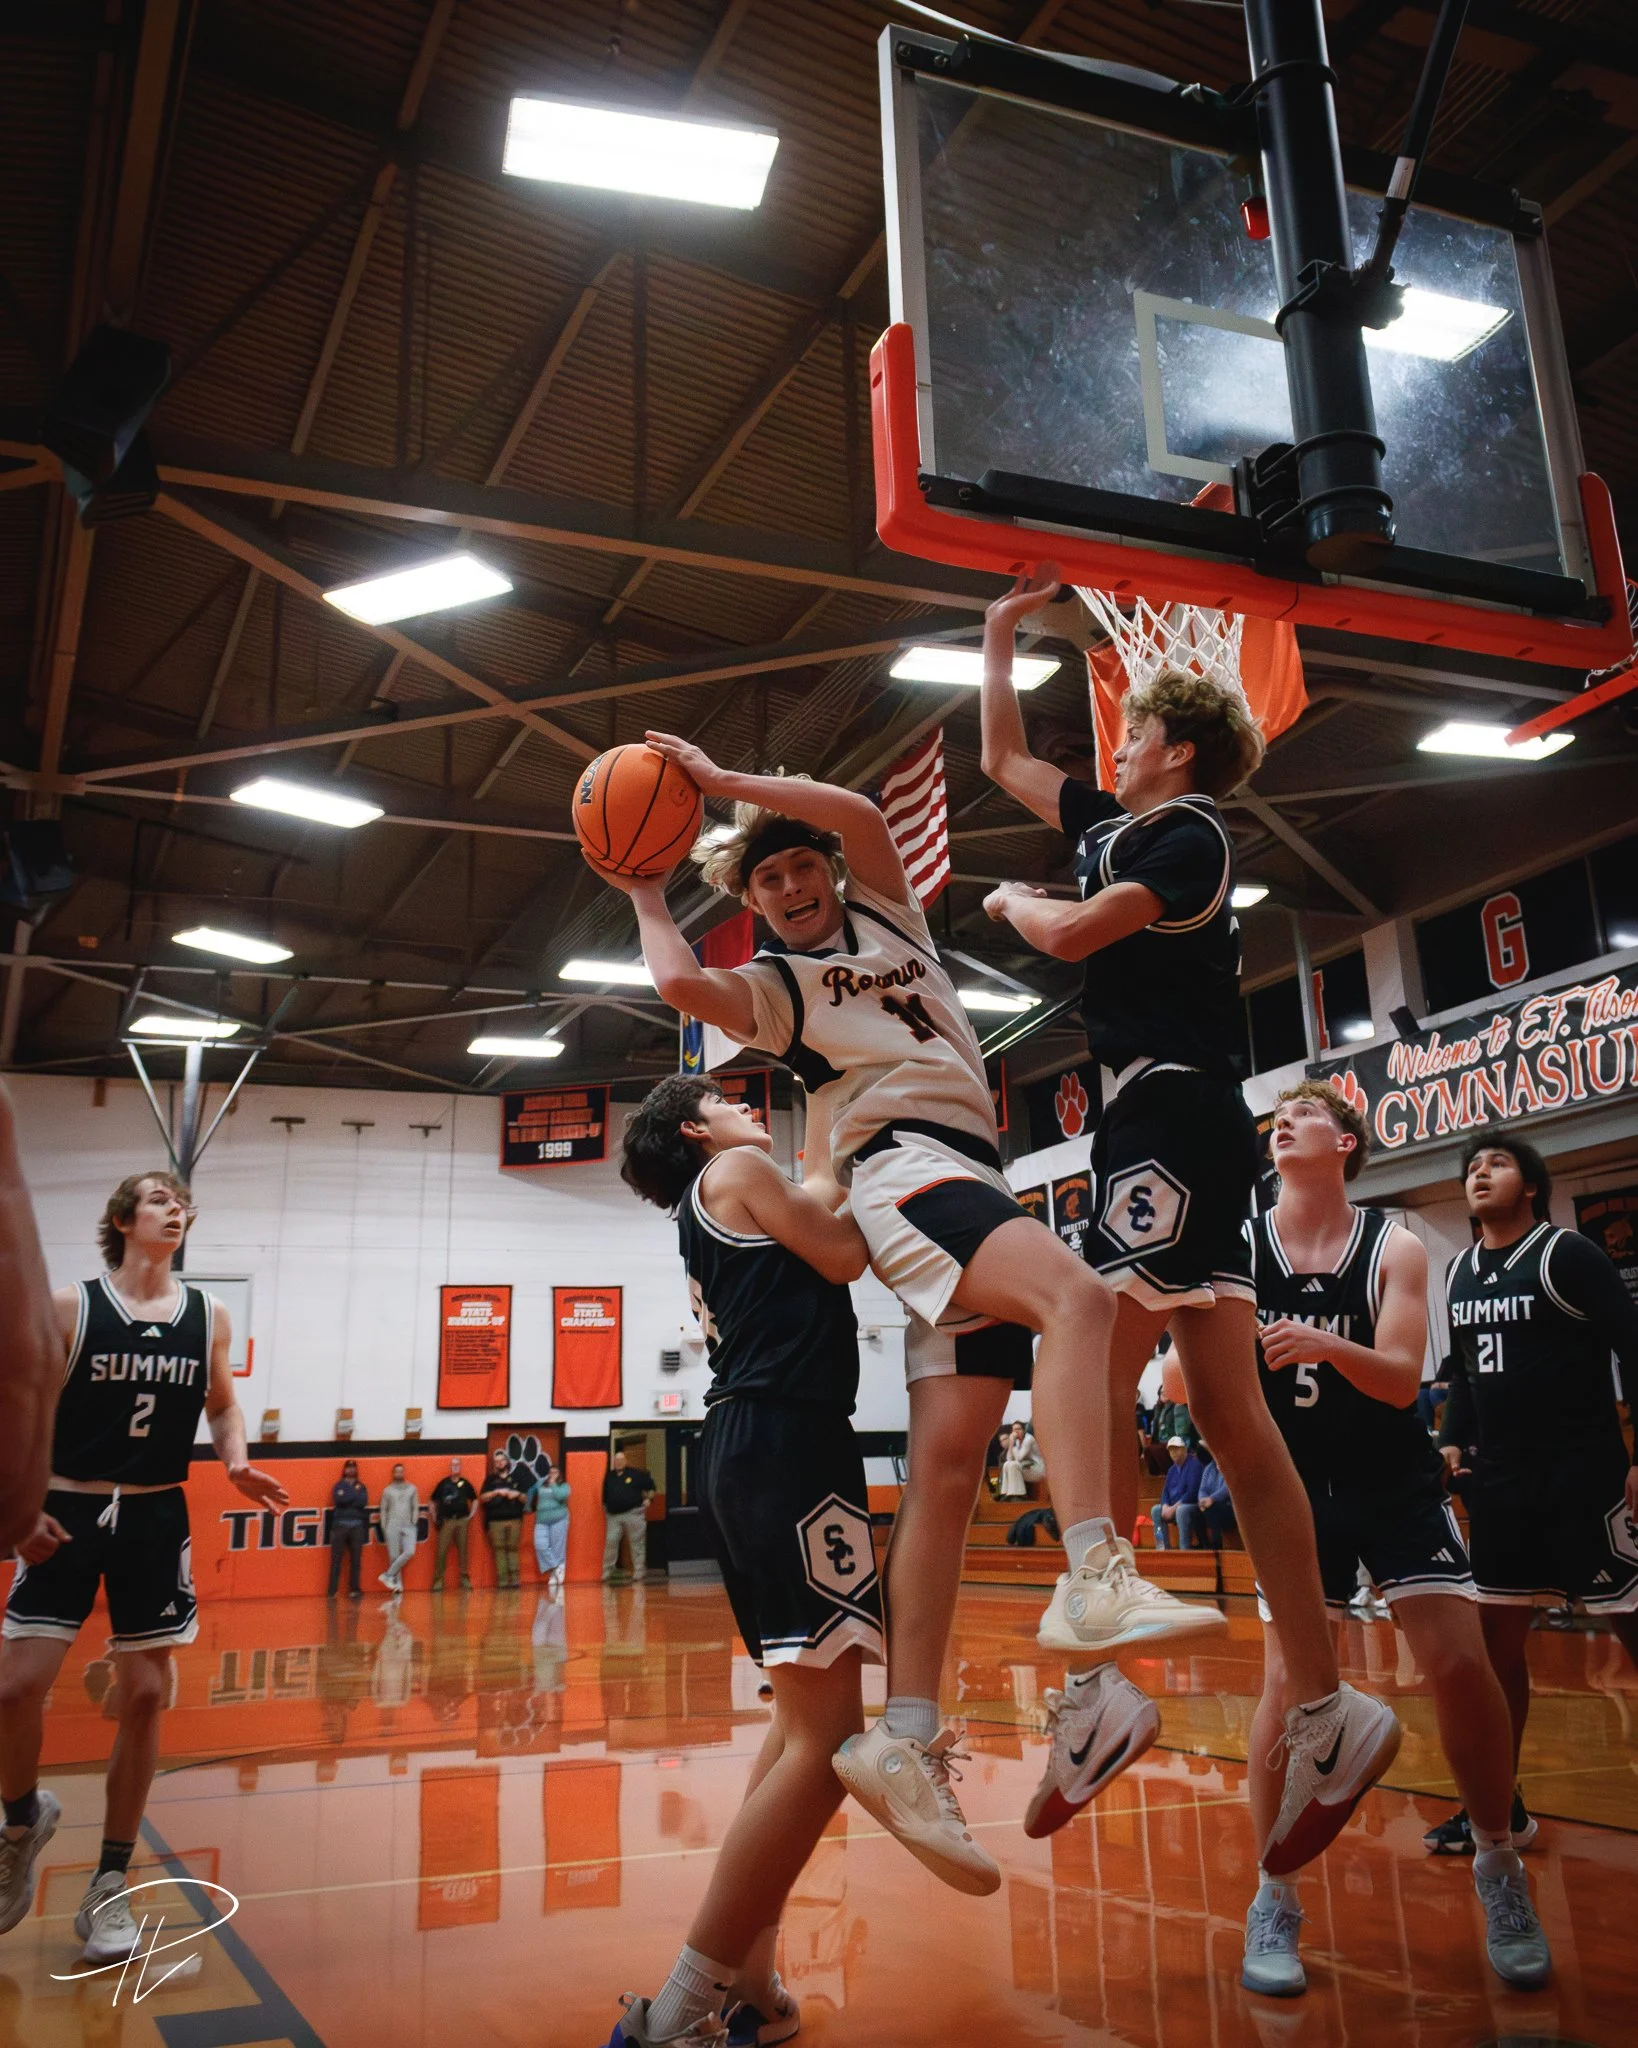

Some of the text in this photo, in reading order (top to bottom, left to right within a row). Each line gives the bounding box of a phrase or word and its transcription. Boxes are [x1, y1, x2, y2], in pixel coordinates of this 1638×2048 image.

[1480, 891, 1530, 990] G
[1387, 1031, 1483, 1085] Welcome
[1479, 1014, 1512, 1057] to
[537, 1141, 573, 1159] 1999
[1127, 1185, 1156, 1233] SC
[1451, 1294, 1535, 1328] SUMMIT
[90, 1353, 200, 1386] SUMMIT
[1477, 1332, 1504, 1373] 21
[1294, 1362, 1320, 1408] 5
[128, 1393, 156, 1438] 2
[823, 1523, 856, 1576] SC
